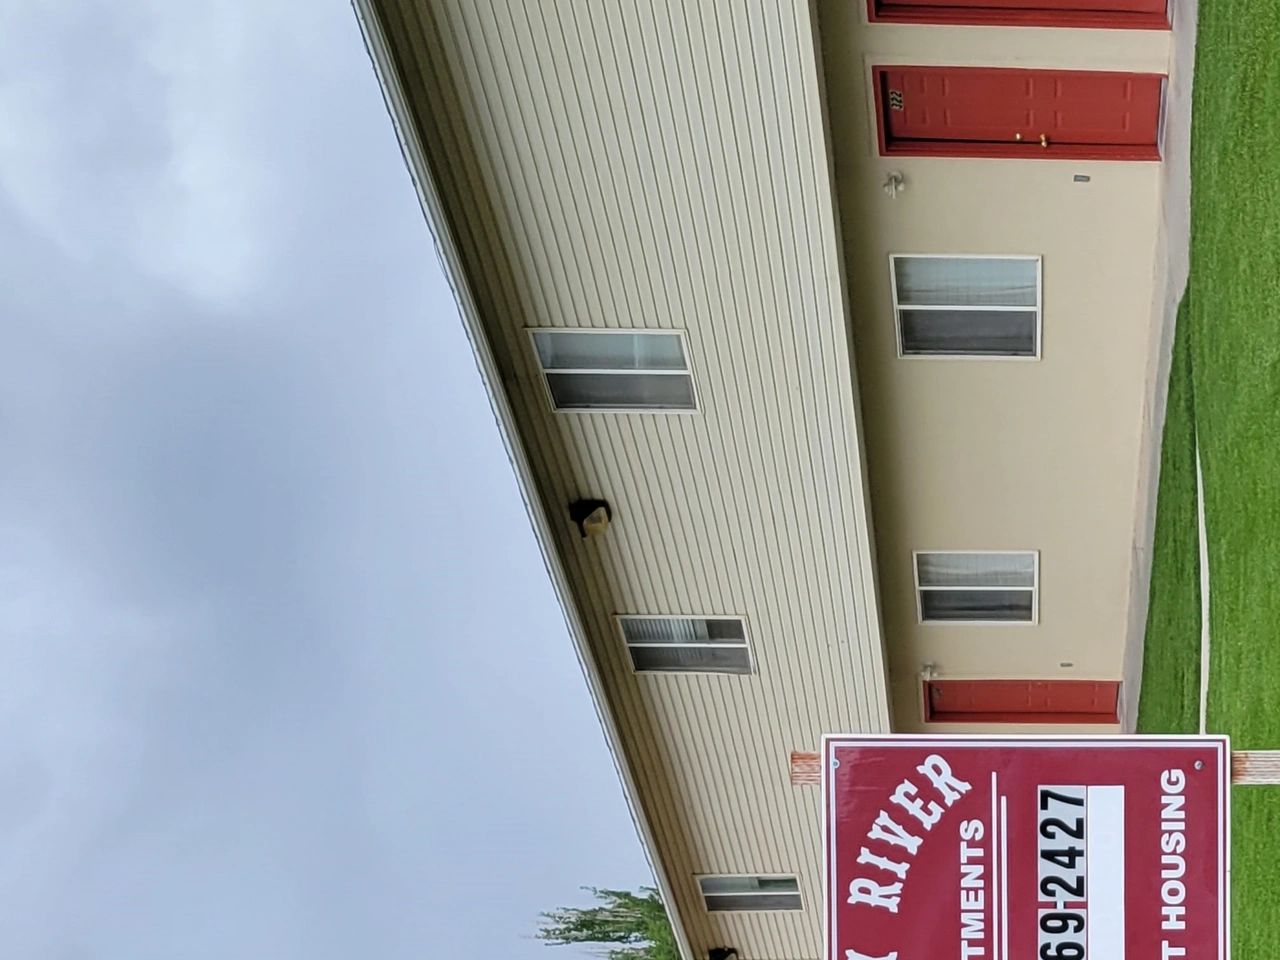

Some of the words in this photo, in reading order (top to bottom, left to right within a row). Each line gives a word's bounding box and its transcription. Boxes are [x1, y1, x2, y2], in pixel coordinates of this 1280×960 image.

[889, 89, 905, 111] 322
[847, 755, 972, 913] RIVER
[1161, 769, 1186, 930] HOUSING
